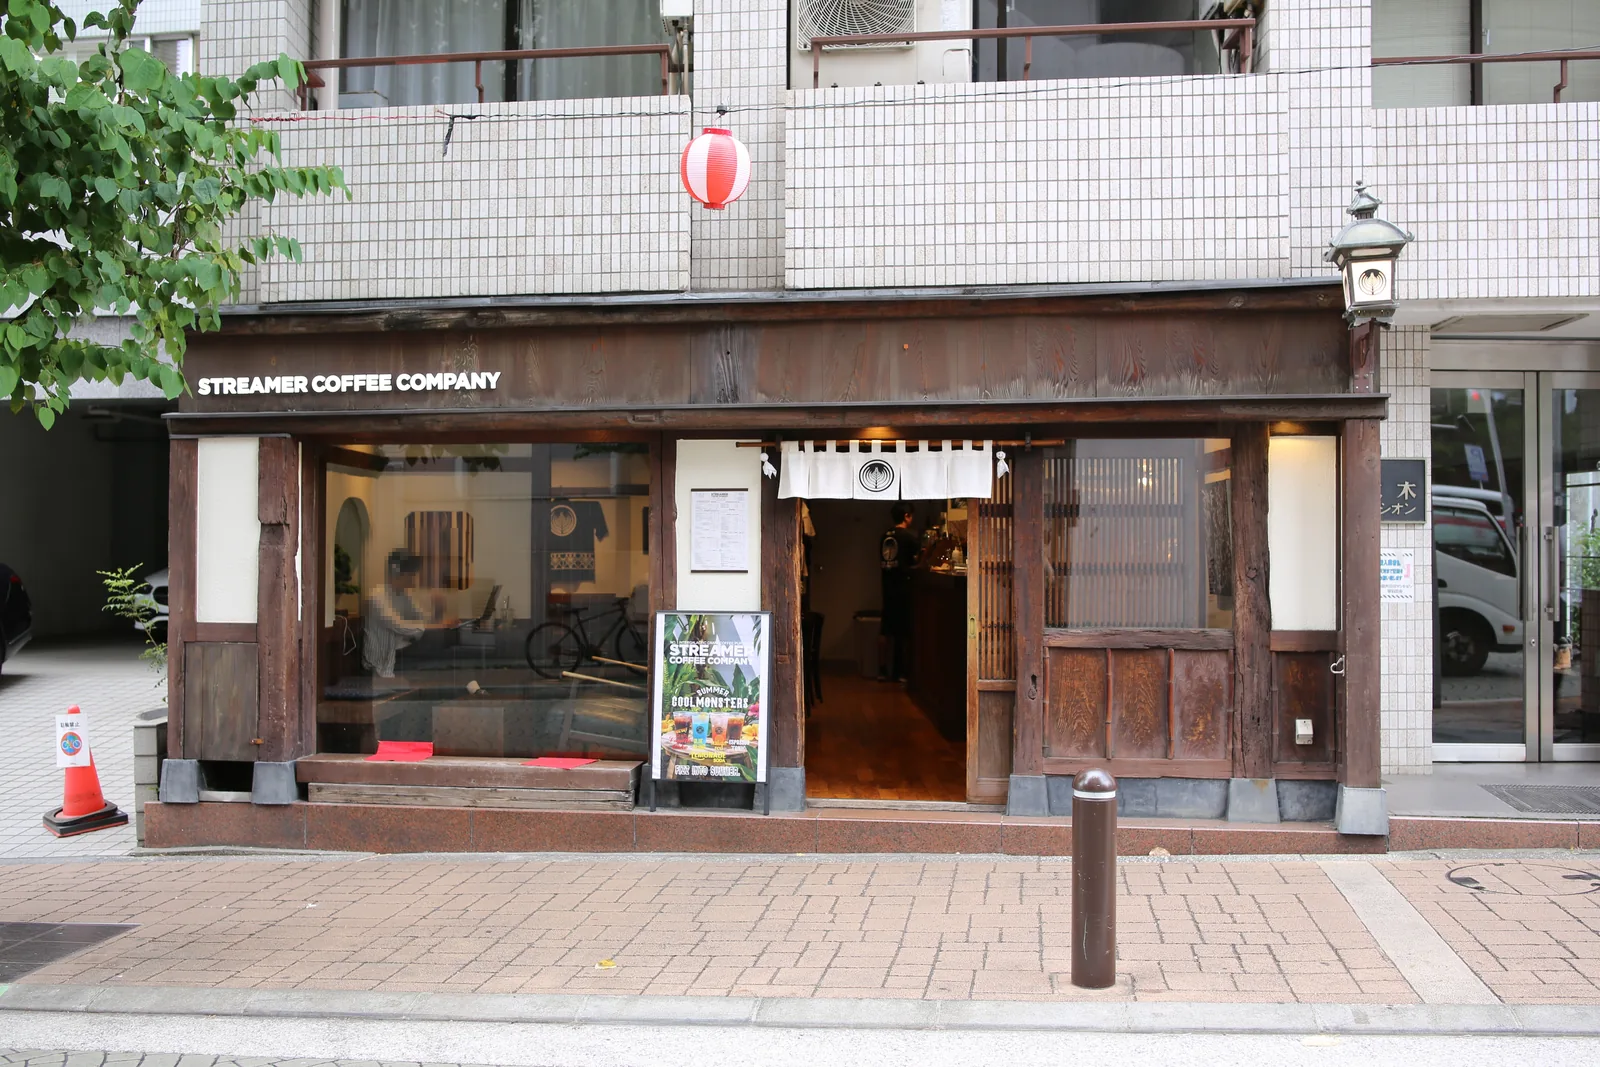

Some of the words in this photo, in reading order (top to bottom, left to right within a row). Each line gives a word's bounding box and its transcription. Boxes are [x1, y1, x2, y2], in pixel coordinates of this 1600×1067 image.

[197, 376, 308, 396] STREAMER
[311, 374, 393, 393] COFFEE
[396, 371, 501, 391] COMPANY
[669, 644, 754, 657] STREAMER
[669, 656, 706, 665] COFFEE
[707, 657, 752, 666] COMPANY
[696, 686, 730, 698] SUMMER
